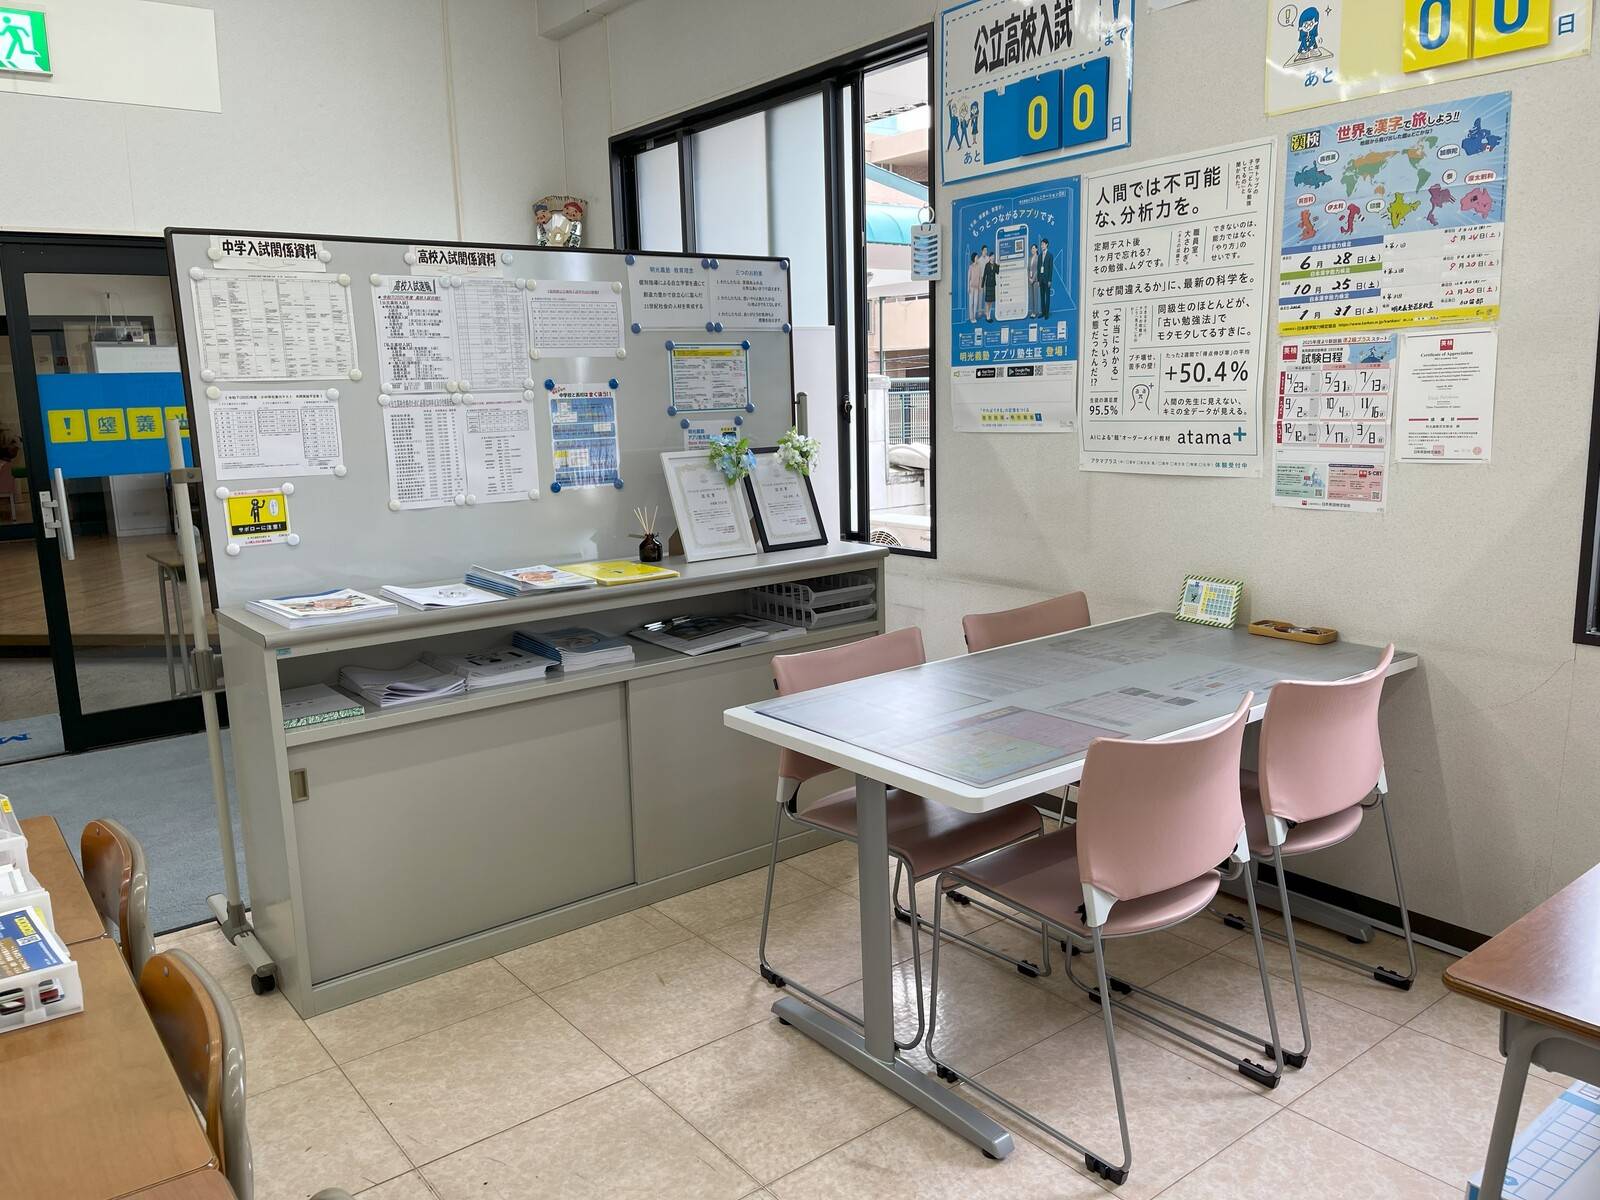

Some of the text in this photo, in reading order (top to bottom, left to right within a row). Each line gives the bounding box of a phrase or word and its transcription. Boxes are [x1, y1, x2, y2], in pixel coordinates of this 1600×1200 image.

[974, 0, 1074, 74] 公立高校入試
[1104, 26, 1128, 46] まで
[1303, 67, 1334, 87] あと
[1557, 13, 1576, 36] 日
[963, 150, 981, 164] あと
[1111, 116, 1122, 133] 日
[1290, 130, 1321, 152] 漢検
[1095, 165, 1221, 207] 人間では不可能
[1095, 196, 1200, 229] な、分析力を。
[1213, 220, 1257, 232] できないのは、
[1212, 230, 1255, 242] 能力ではなく、
[222, 239, 317, 260] 中学入試関係資料
[1094, 237, 1141, 252] 定期テスト後
[1212, 241, 1247, 252] 「やり方」の
[418, 249, 497, 267] 高校入試関係資料
[1211, 252, 1240, 262] せいです。
[1092, 258, 1164, 274] その勉強、ムダです。
[1092, 272, 1254, 297] 「なぜ間違えるか」に、最新の科学を。
[1157, 299, 1250, 314] 同級生のほとんどが、
[1158, 314, 1227, 328] 「古い勉強法」で
[1101, 309, 1110, 367] ってこういう
[1157, 326, 1252, 340] モタモタしてるすきに。
[1111, 307, 1121, 381] 「本当にわかる」
[1301, 352, 1344, 364] 試験日程
[1165, 360, 1248, 383] +50.4%
[1164, 398, 1242, 406] 人間の先生に見えない、
[1089, 405, 1118, 416] 95.5%
[1163, 407, 1248, 416] キミの全データが見える。
[238, 523, 282, 533] サボローに注意!
